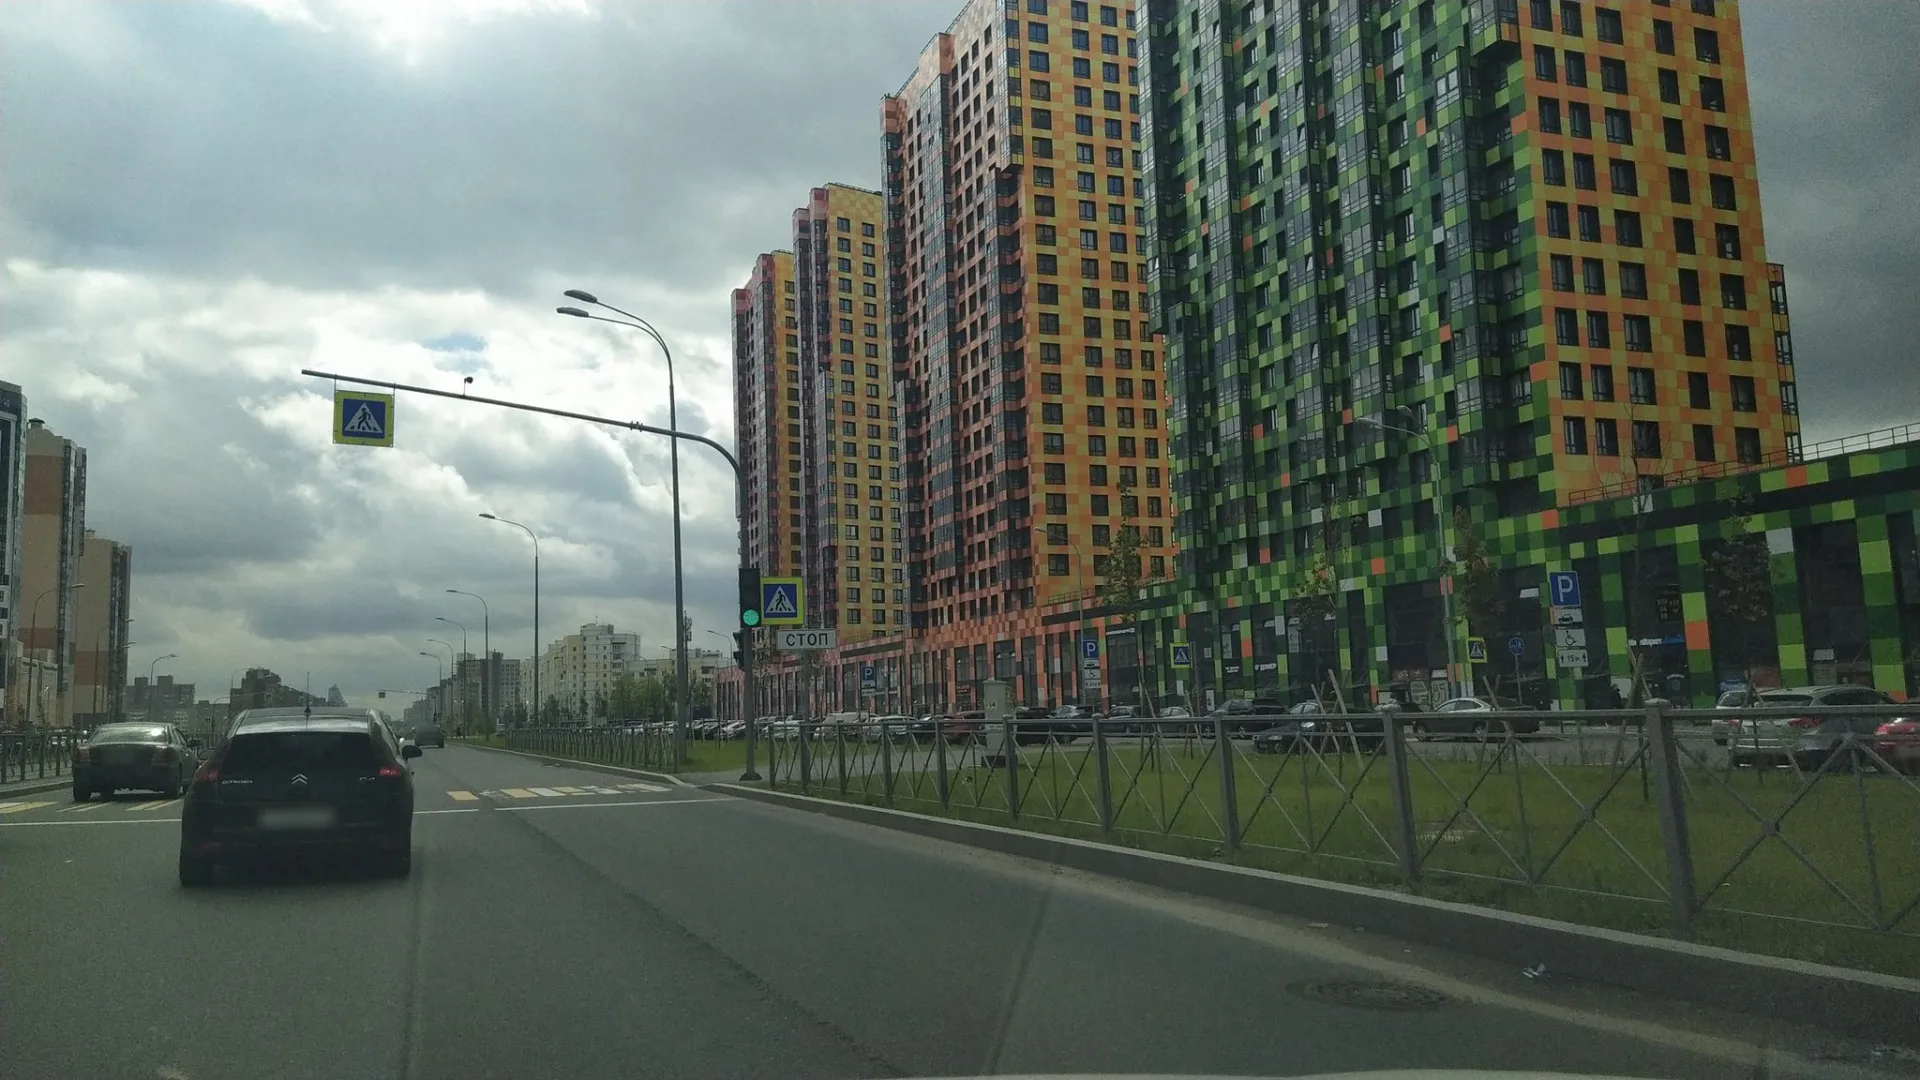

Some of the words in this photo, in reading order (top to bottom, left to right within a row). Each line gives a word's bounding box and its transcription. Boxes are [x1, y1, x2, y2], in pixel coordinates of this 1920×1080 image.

[1558, 575, 1573, 602] P
[786, 633, 828, 646] СТОП
[1087, 642, 1096, 656] P
[865, 667, 872, 679] P
